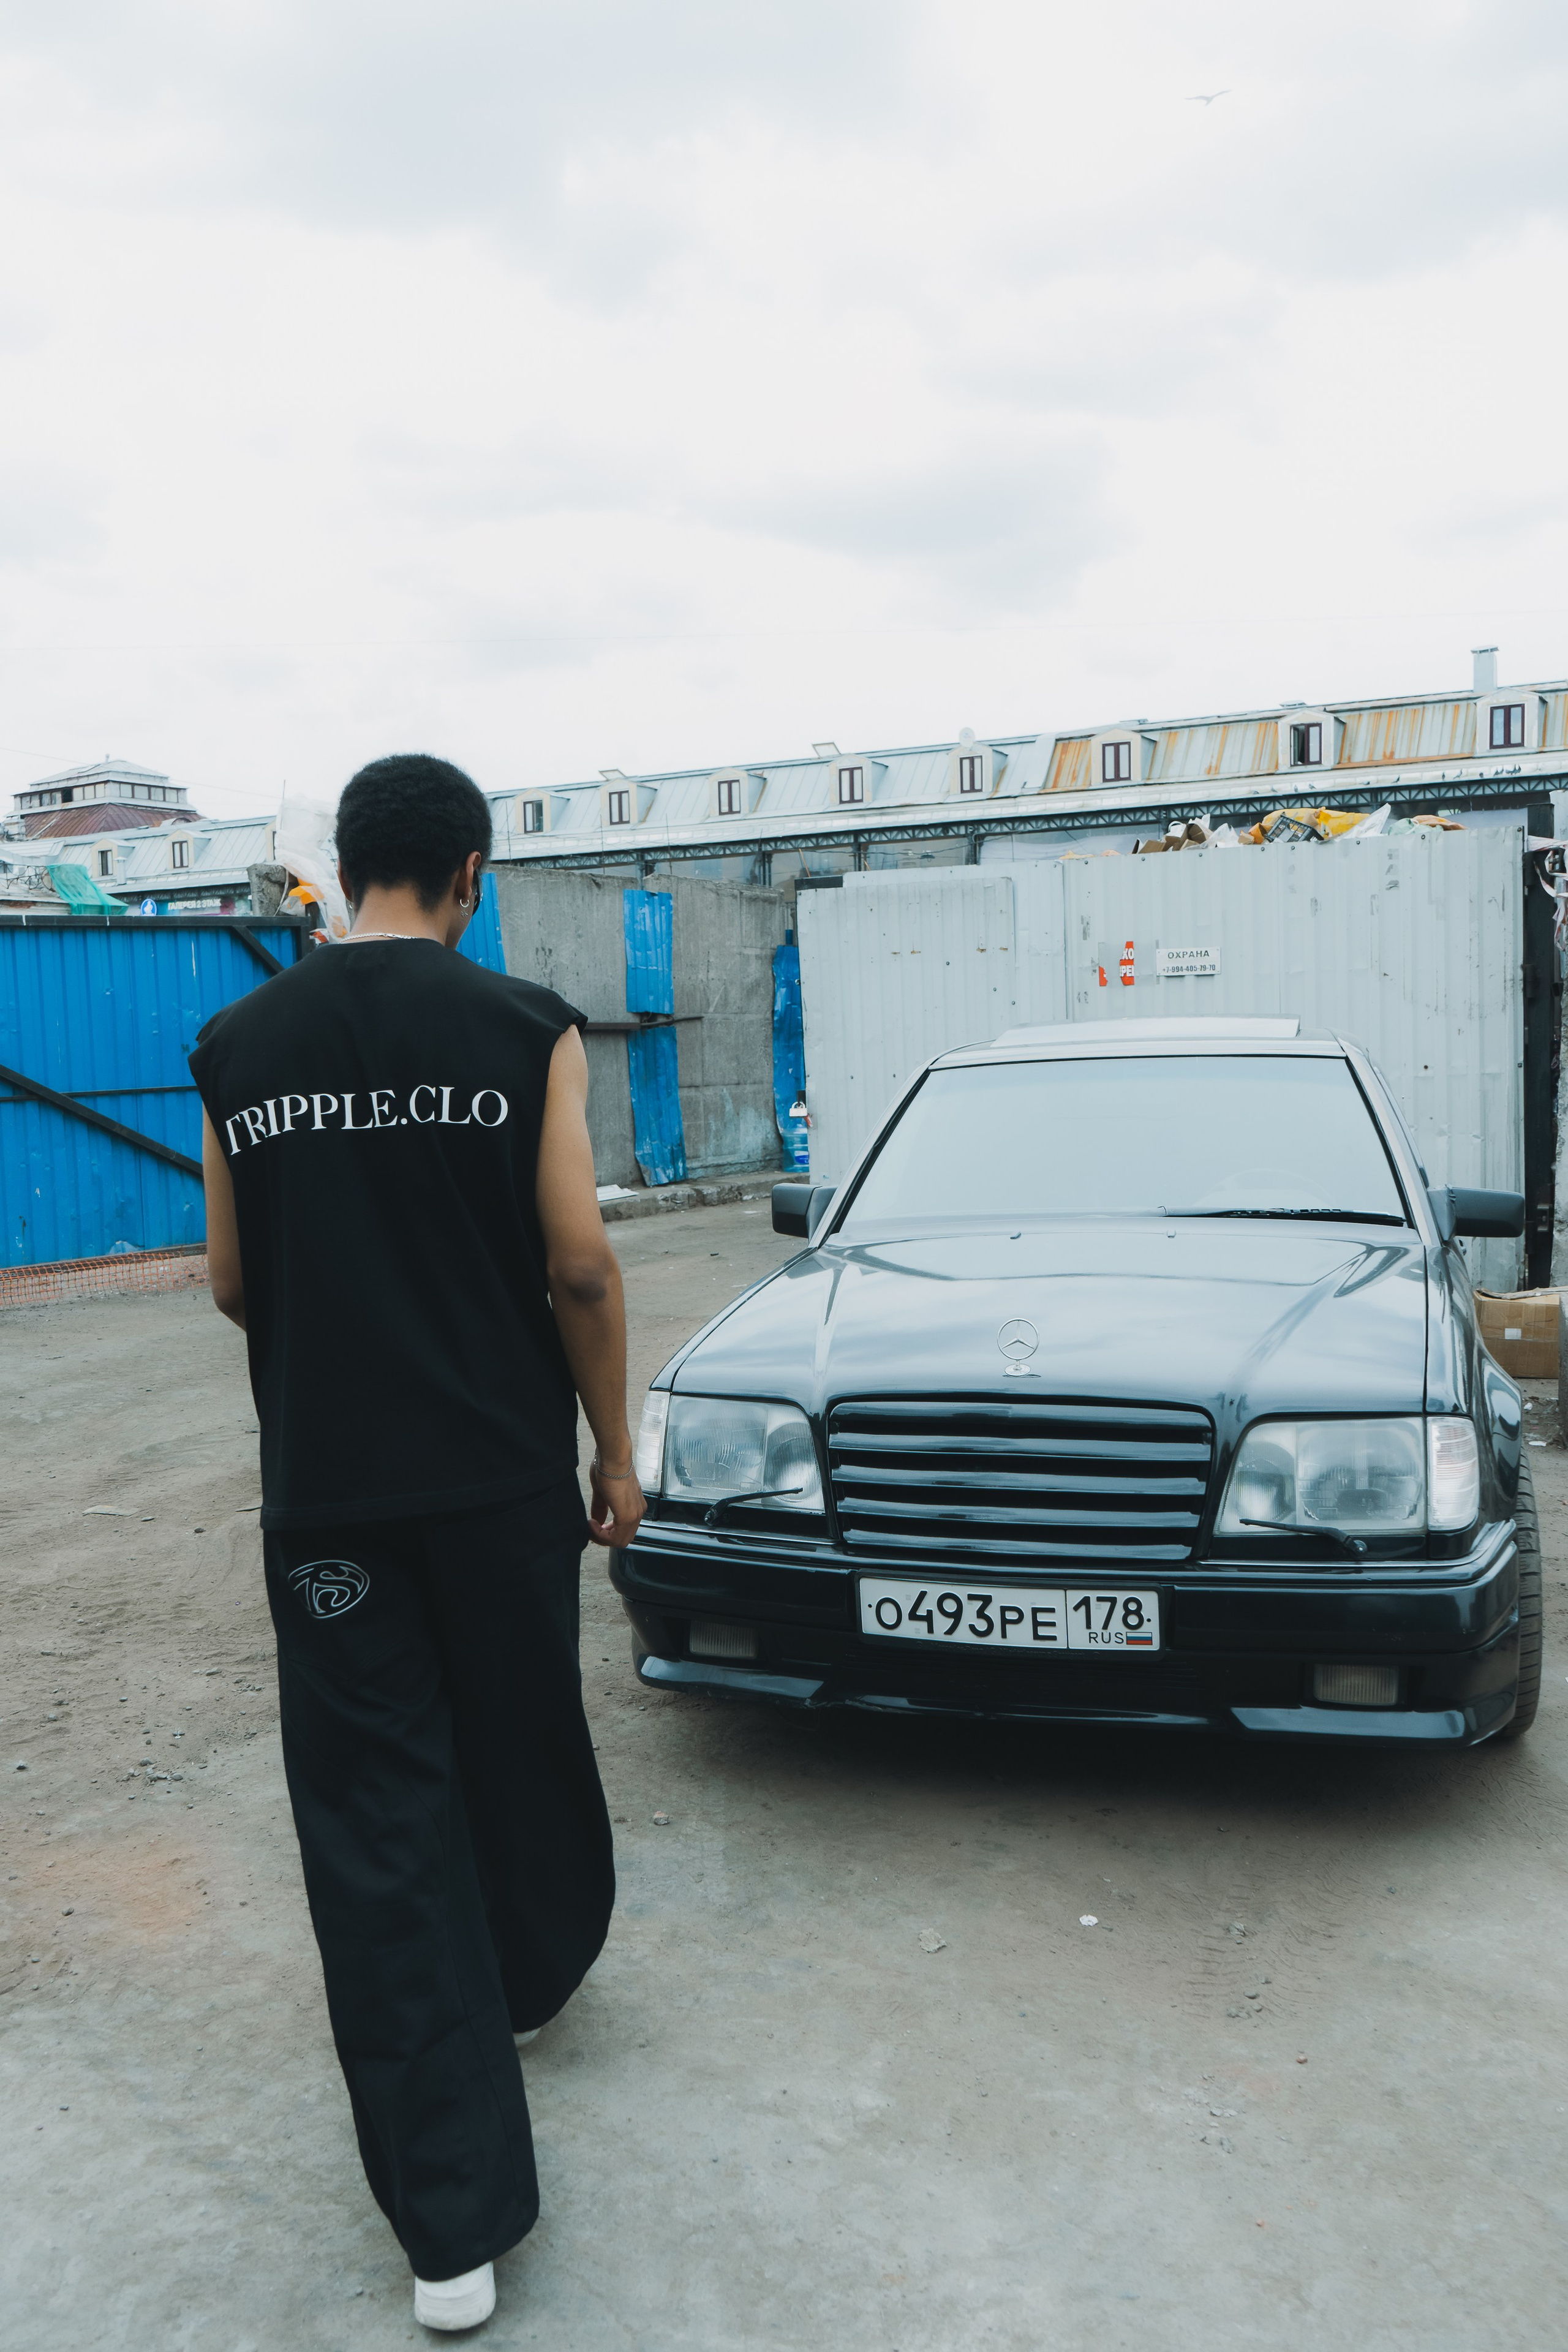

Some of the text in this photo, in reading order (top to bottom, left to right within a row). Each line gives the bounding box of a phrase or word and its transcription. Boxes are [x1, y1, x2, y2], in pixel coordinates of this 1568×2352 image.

[1167, 950, 1210, 959] ОХРАНА
[1163, 964, 1216, 973] +7-994-405-79-70
[875, 1590, 1145, 1641] О493РЕ 178
[1088, 1631, 1125, 1645] RUS
